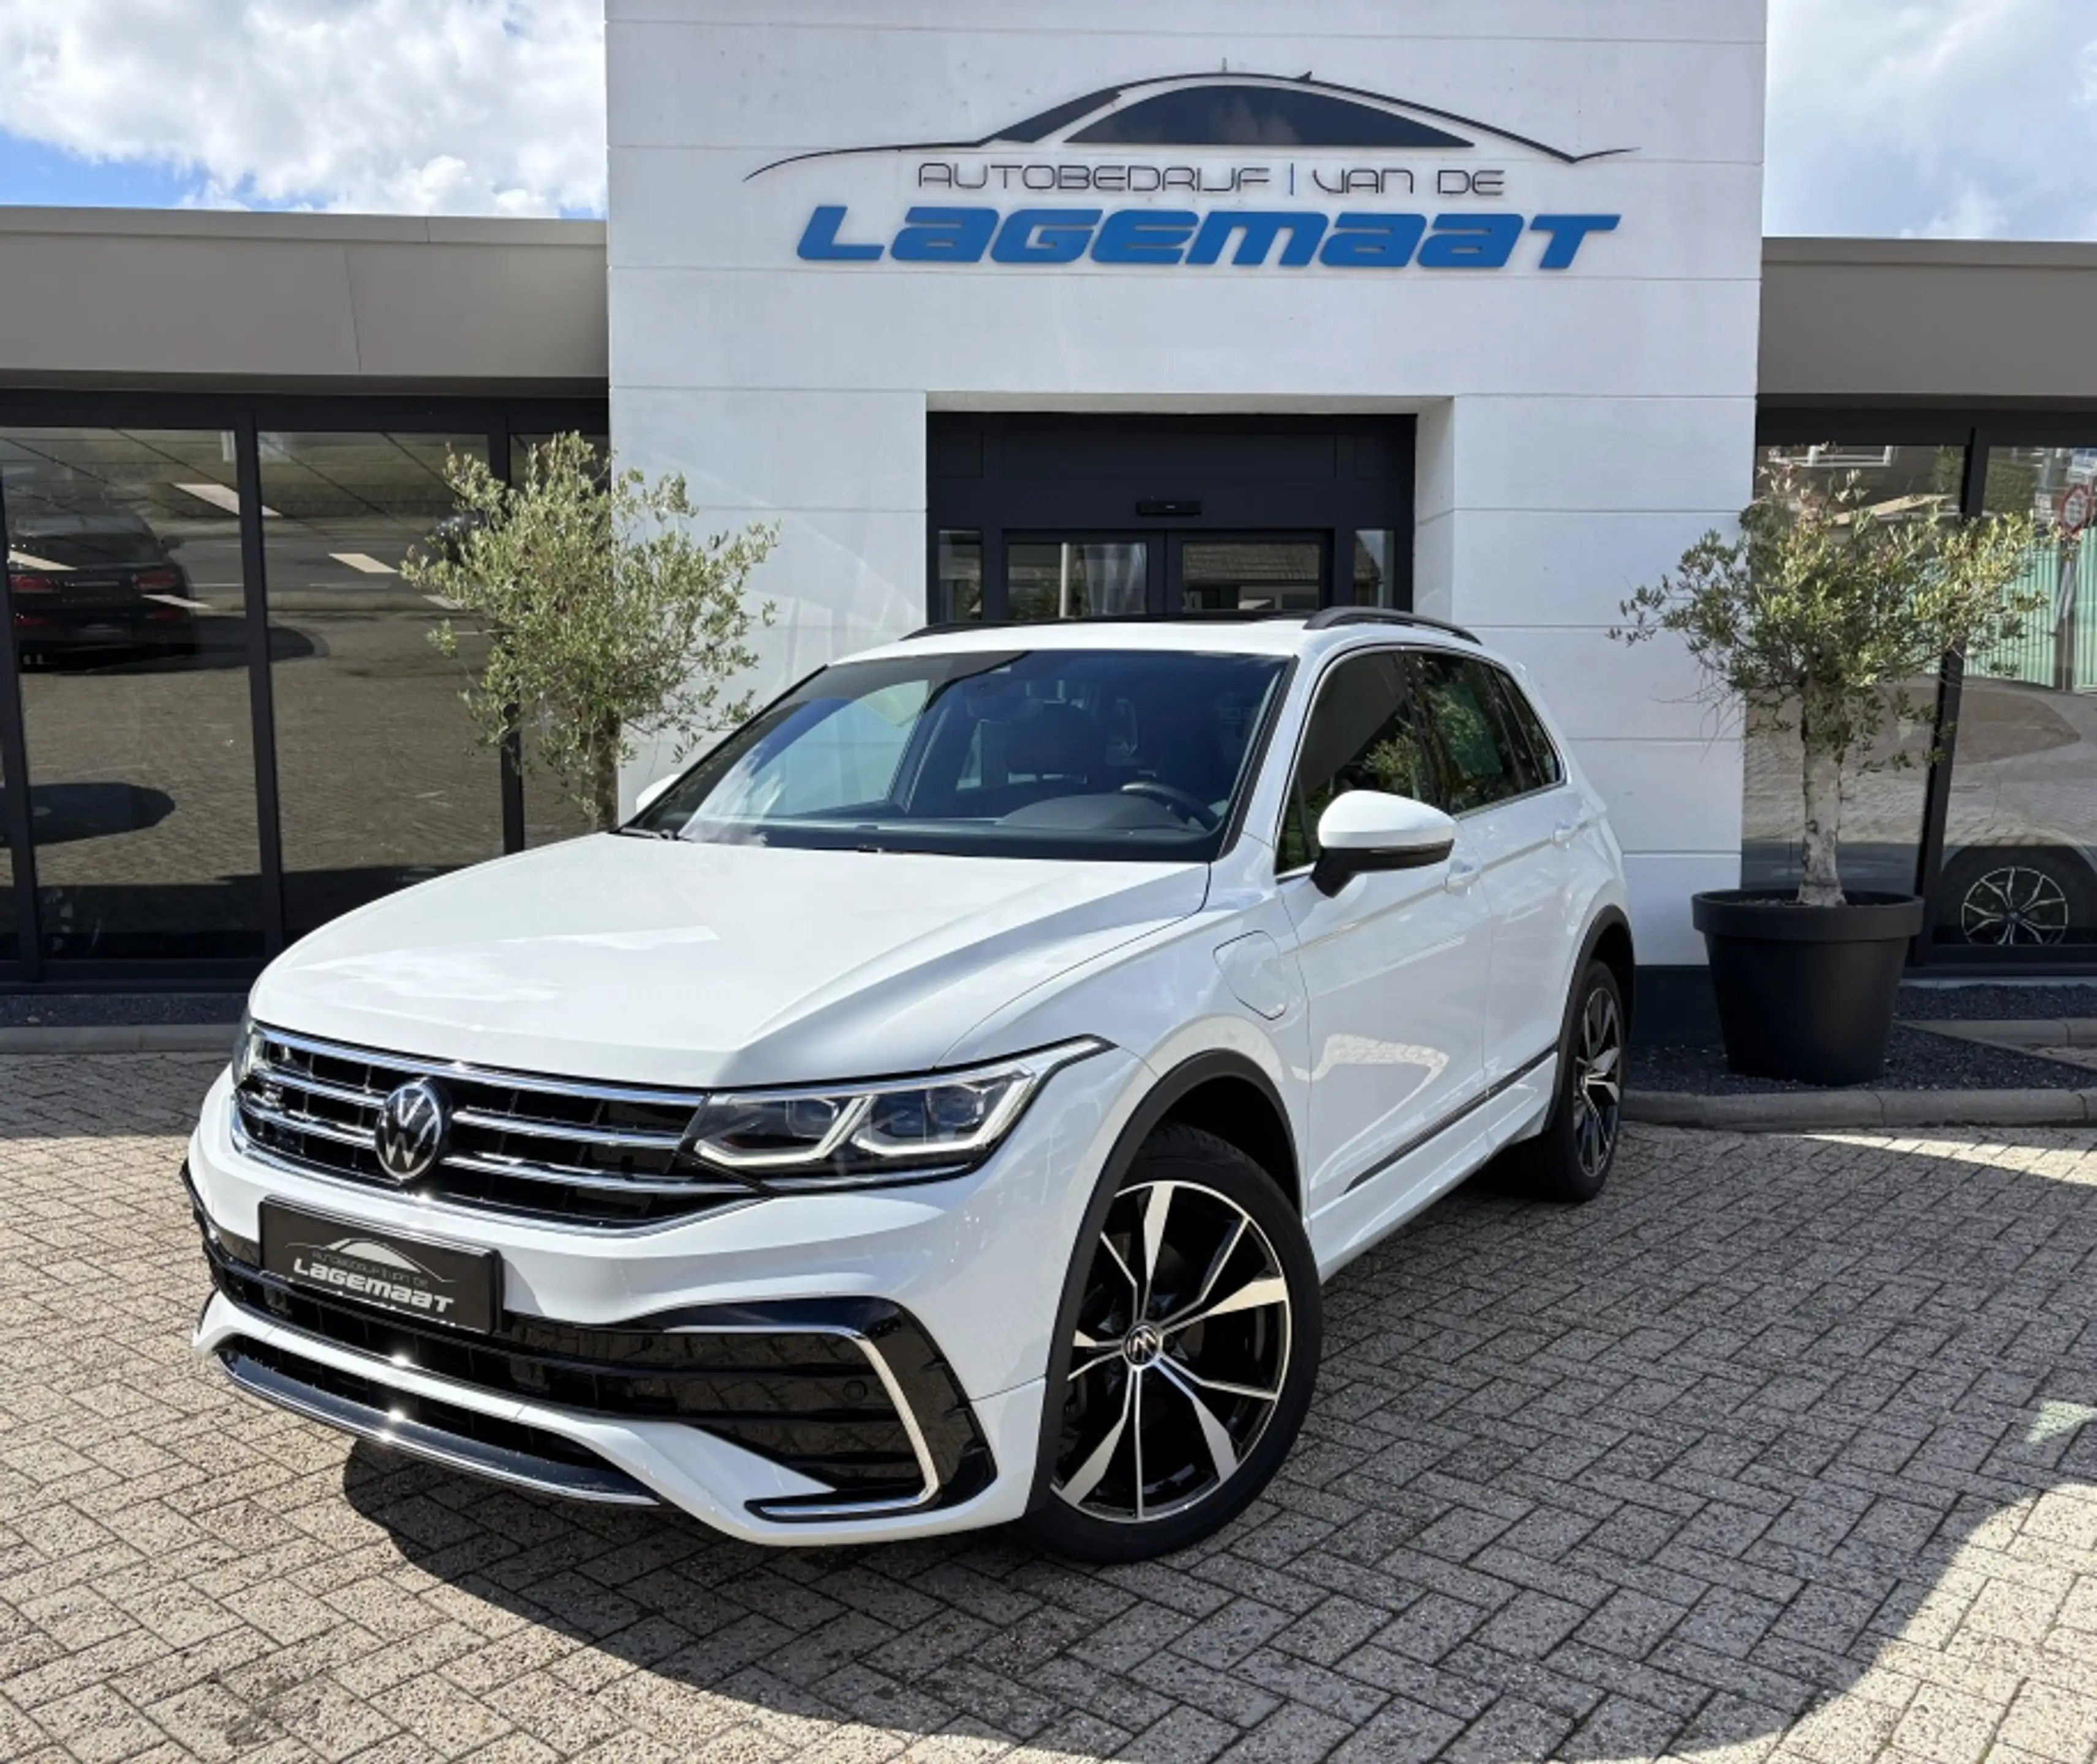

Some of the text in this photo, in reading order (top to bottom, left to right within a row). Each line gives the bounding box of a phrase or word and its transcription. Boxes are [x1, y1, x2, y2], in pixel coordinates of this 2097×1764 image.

[919, 163, 1505, 195] AUTOBEDRIJF VAN DE
